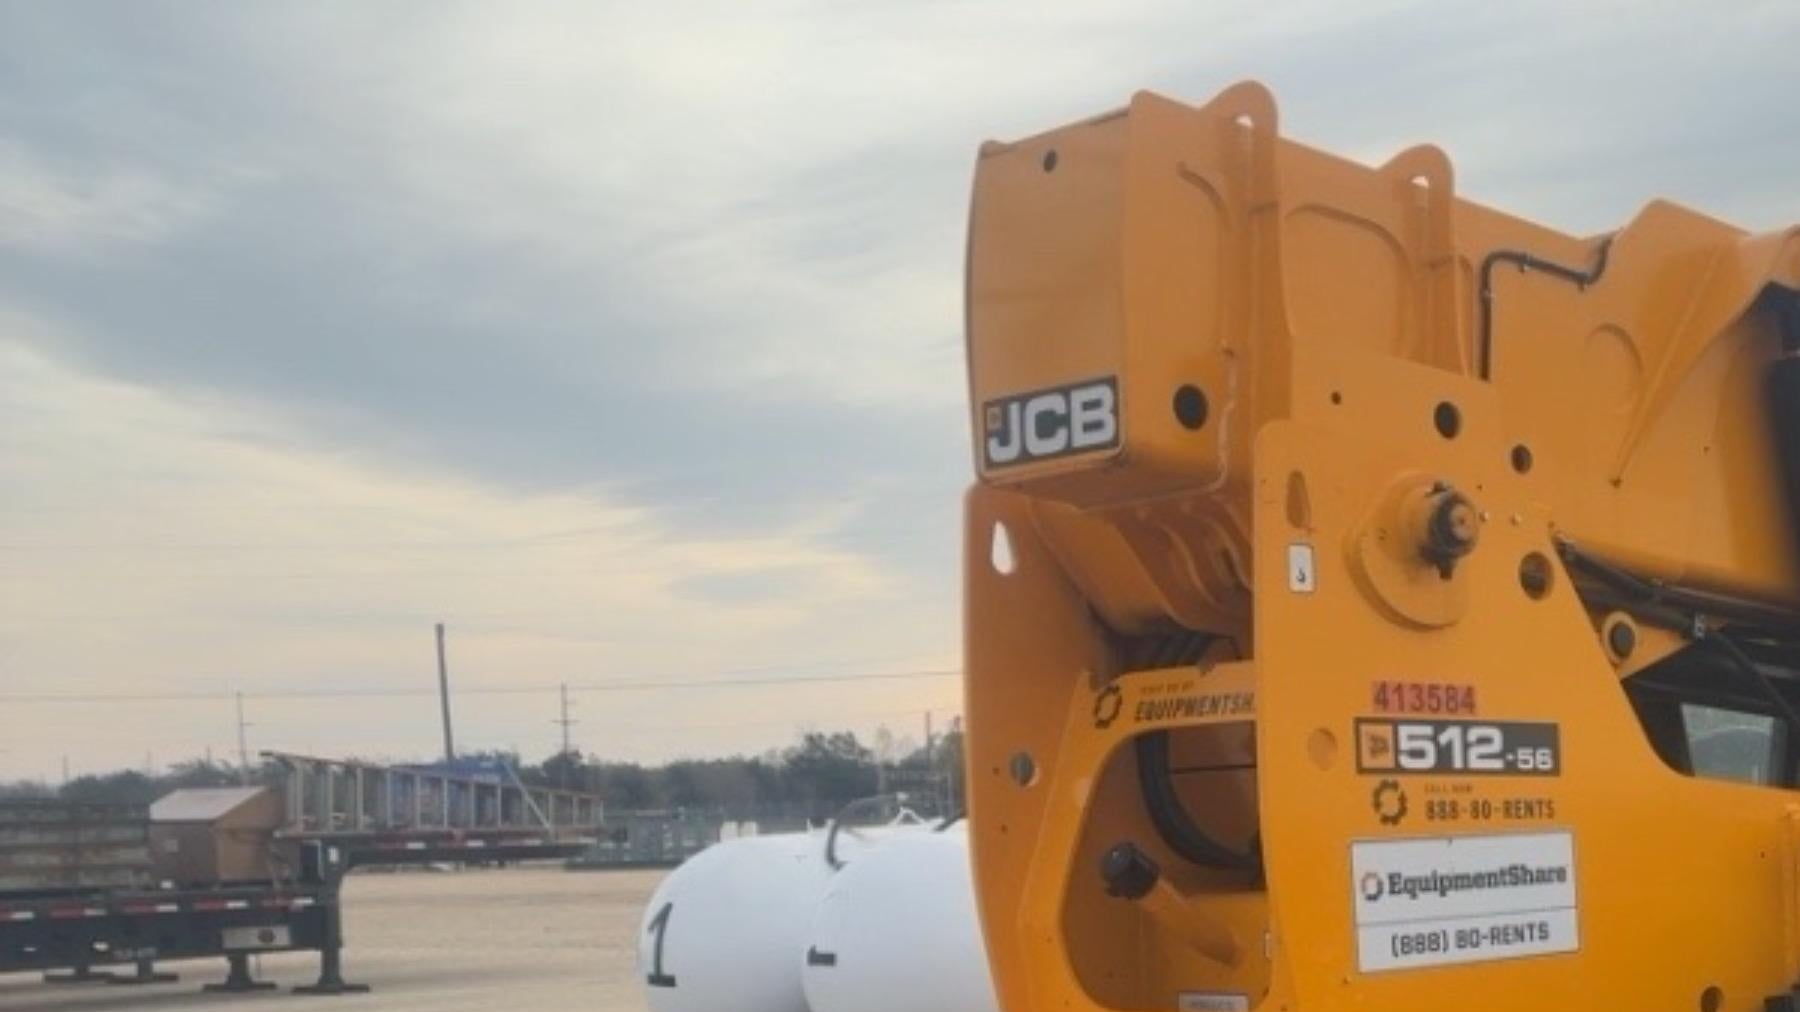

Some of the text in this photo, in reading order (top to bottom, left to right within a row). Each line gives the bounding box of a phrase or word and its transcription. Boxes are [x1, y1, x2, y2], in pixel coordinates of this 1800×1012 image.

[986, 383, 1118, 464] JCB
[1374, 680, 1476, 715] 413584
[1387, 863, 1568, 900] EquipmentShare
[1390, 929, 1449, 958] (888)
